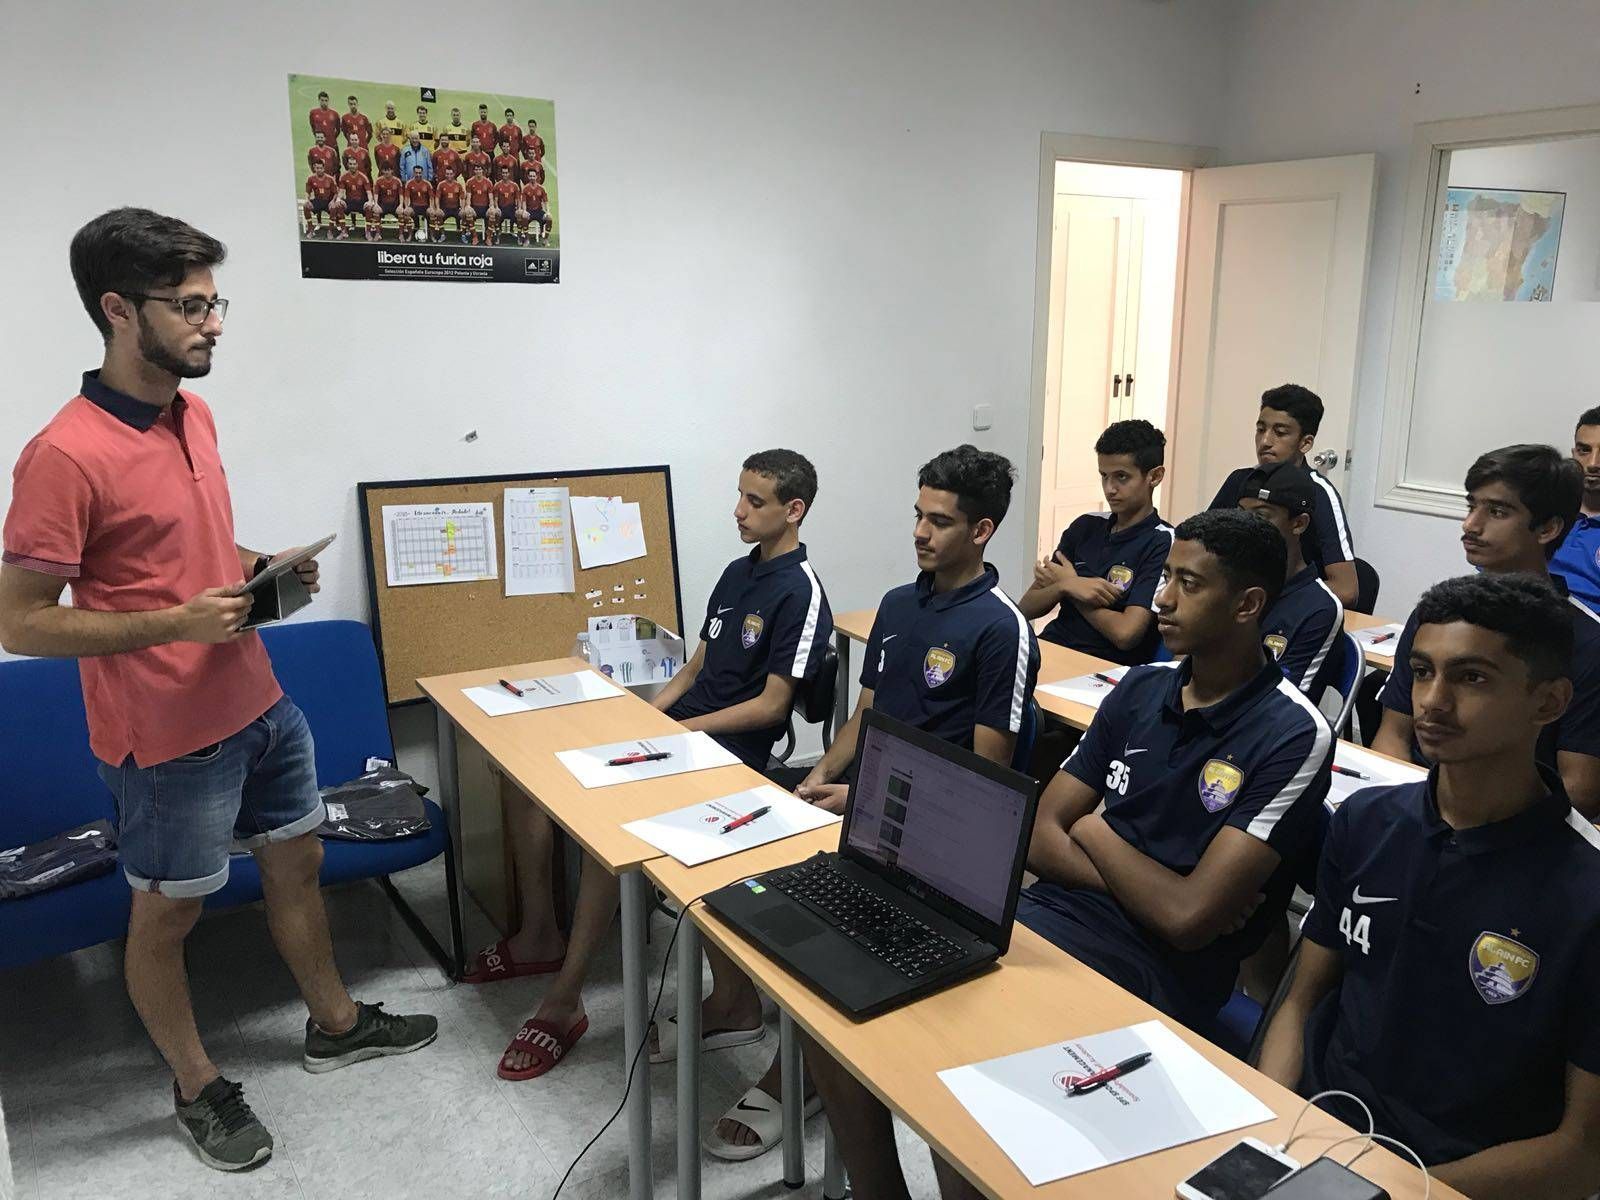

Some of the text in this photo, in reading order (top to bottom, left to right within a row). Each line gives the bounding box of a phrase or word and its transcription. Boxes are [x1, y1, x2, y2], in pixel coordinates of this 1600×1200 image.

[377, 250, 493, 269] libera tu furia roja
[708, 617, 723, 639] 10
[1105, 760, 1131, 795] 35
[1339, 906, 1371, 955] 44
